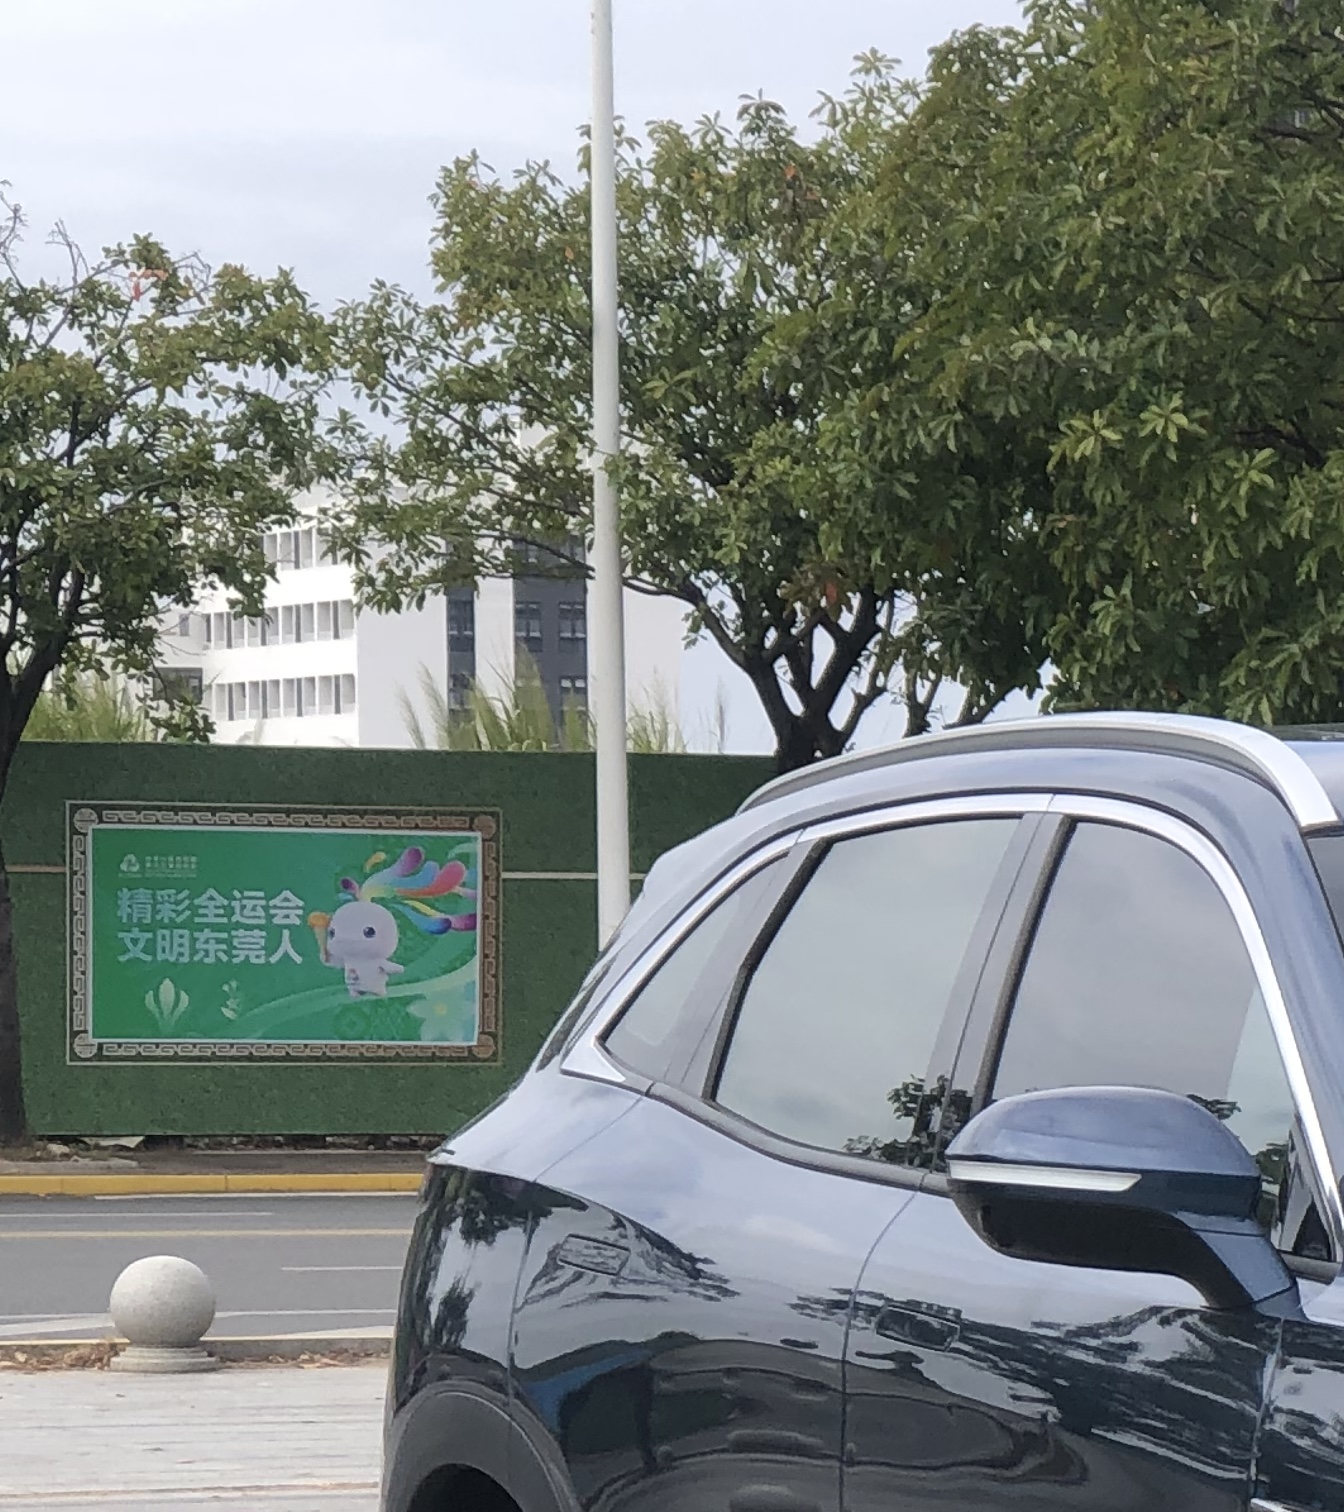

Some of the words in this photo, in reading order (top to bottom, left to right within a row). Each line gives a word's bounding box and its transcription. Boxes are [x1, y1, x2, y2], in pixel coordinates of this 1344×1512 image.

[117, 887, 305, 925] 精彩全运会
[117, 927, 303, 965] 文明东莞人
